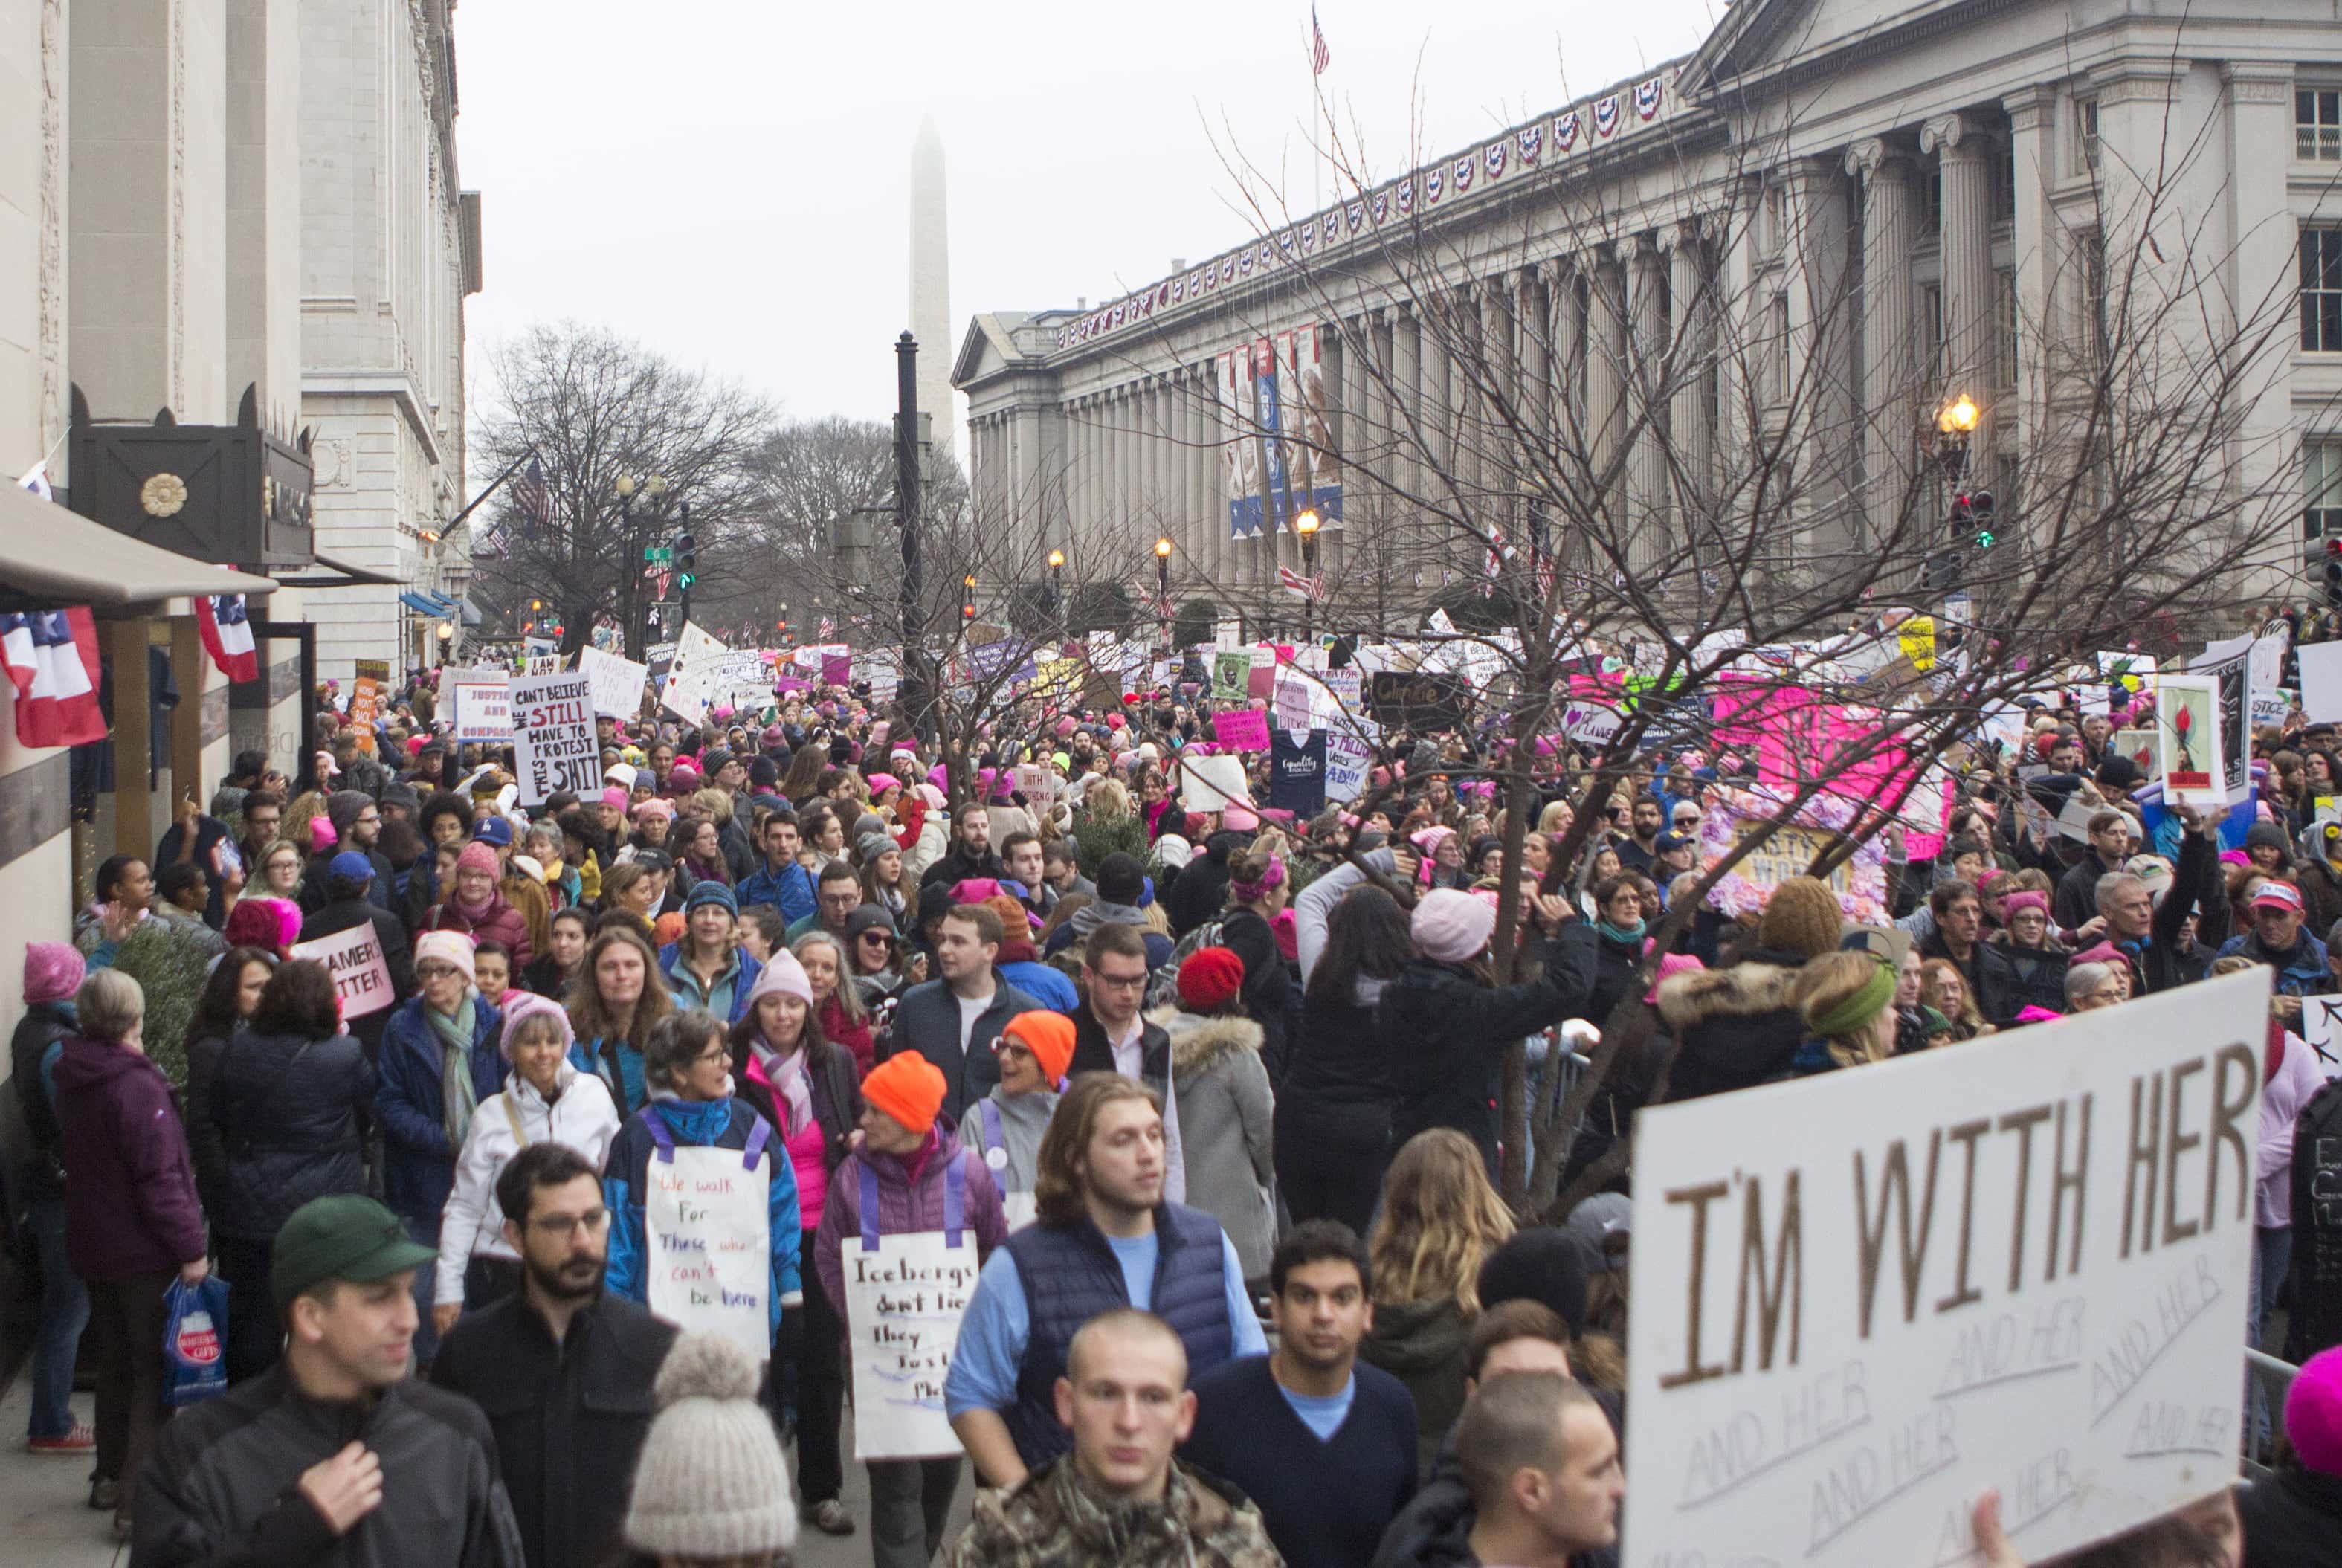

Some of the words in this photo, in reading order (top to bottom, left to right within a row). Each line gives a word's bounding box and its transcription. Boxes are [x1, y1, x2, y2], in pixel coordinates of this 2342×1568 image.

[540, 658, 554, 668] AM
[597, 656, 631, 680] MADE
[546, 681, 590, 700] BELIEVE
[604, 674, 619, 690] IN
[471, 690, 511, 701] JUSTIC
[485, 706, 507, 716] AND
[530, 701, 587, 727] STILL
[2253, 700, 2285, 714] STICE
[512, 711, 528, 731] WE
[1332, 715, 1353, 731] LOST
[1577, 711, 1613, 739] PLANNE
[529, 727, 564, 743] HAVE
[569, 724, 586, 738] TO
[1326, 730, 1338, 747] 3
[1642, 729, 1671, 738] HUMAN
[535, 738, 593, 758] PROTEST
[1282, 755, 1317, 771] Equality
[532, 759, 550, 798] THIS
[552, 755, 599, 794] SHIT
[1325, 765, 1361, 784] AD!!!
[328, 937, 382, 972] AMERS
[337, 968, 384, 998] TTER
[659, 1171, 685, 1190] We
[695, 1177, 733, 1194] walk
[678, 1200, 709, 1223] For
[1659, 1166, 1803, 1390] I'M
[1853, 1090, 2097, 1340] WITH
[2118, 1041, 2259, 1261] HER
[719, 1237, 746, 1251] who
[671, 1260, 720, 1280] can't
[854, 1256, 972, 1288] Icebergs
[690, 1287, 712, 1306] be
[721, 1286, 758, 1308] here
[938, 1292, 965, 1311] lie
[870, 1323, 920, 1350] They
[2090, 1319, 2151, 1410] AND
[2157, 1254, 2224, 1338] HER
[1938, 1314, 2018, 1393] AND
[2025, 1296, 2086, 1365] HER
[1681, 1410, 1765, 1497] AND
[1783, 1357, 1871, 1448] HER
[2129, 1401, 2187, 1451] AND
[1810, 1445, 1881, 1546] AND
[1890, 1402, 1959, 1485] HER
[2016, 1448, 2074, 1519] HER
